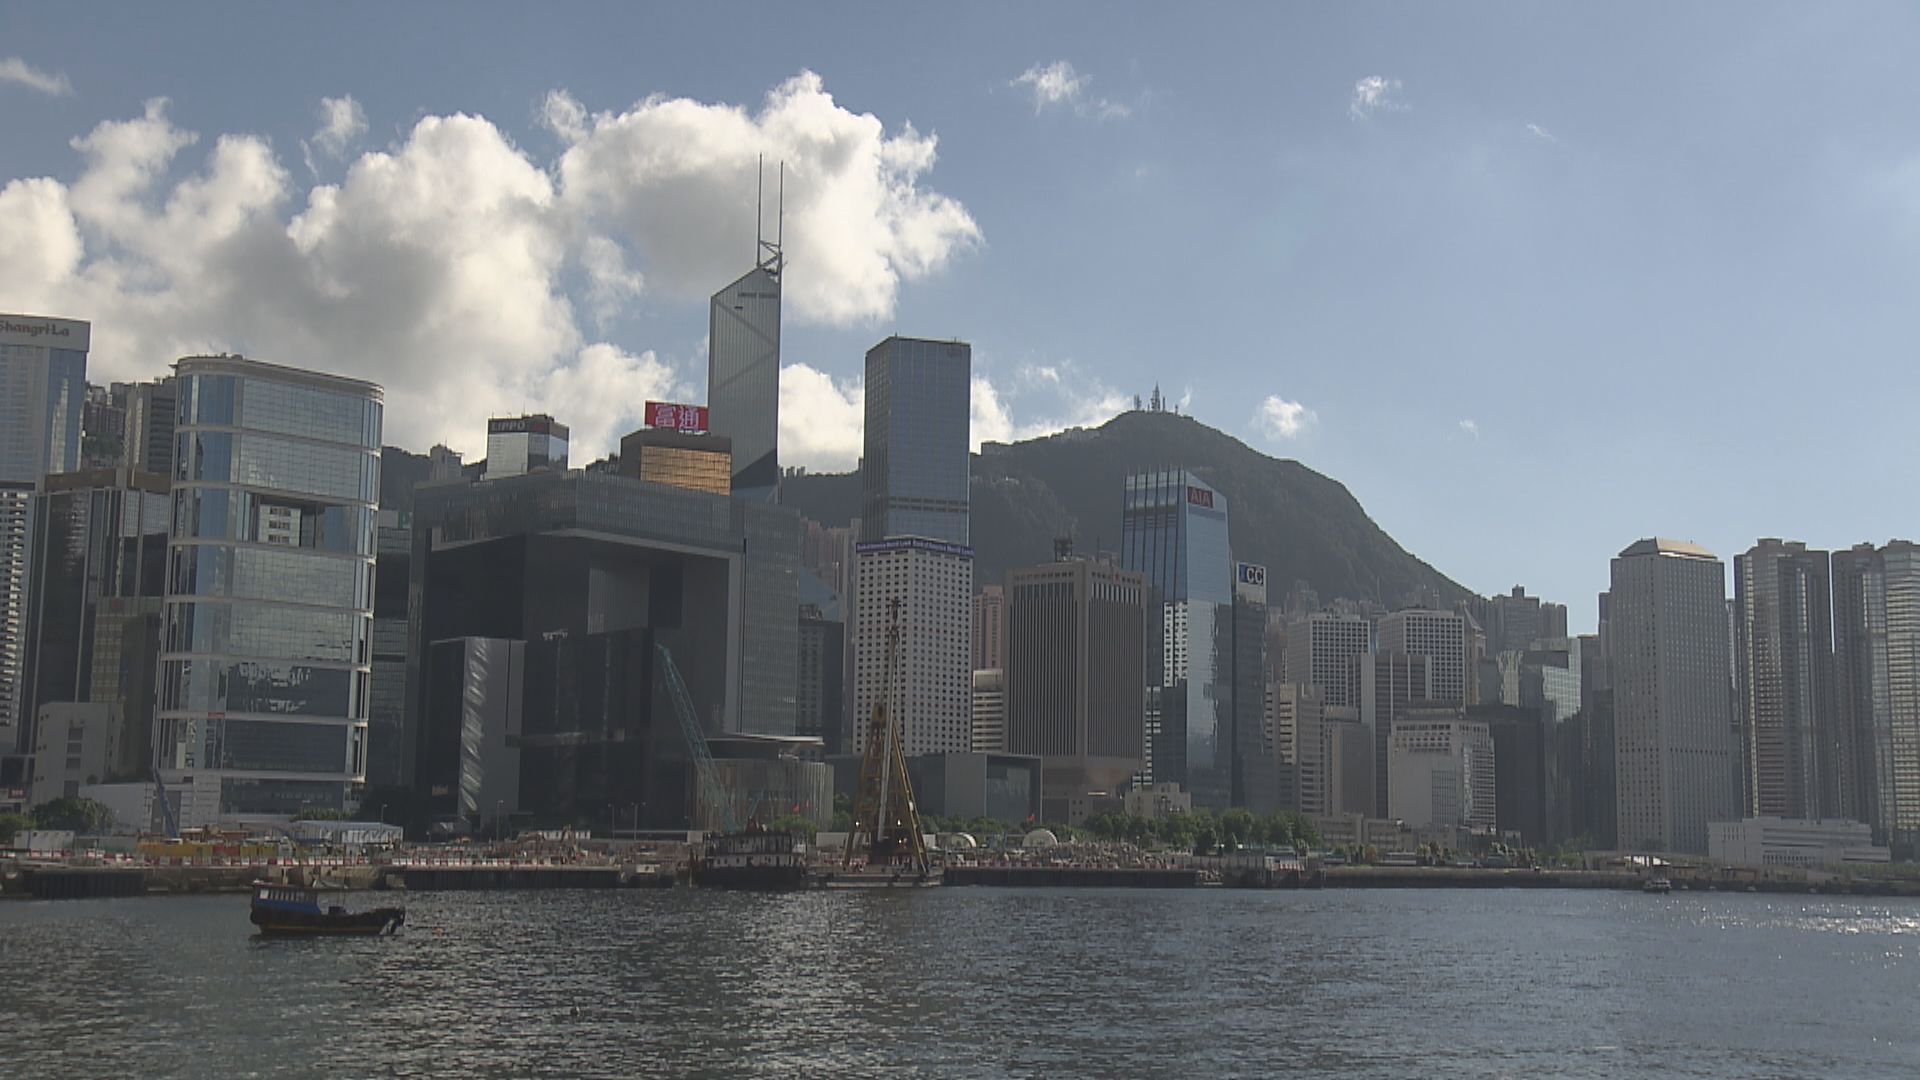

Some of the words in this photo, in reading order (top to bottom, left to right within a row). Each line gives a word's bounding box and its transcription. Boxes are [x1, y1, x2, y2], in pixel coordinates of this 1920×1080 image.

[491, 421, 526, 431] LIPPO
[655, 404, 699, 431] 富通
[1190, 489, 1211, 507] AIA
